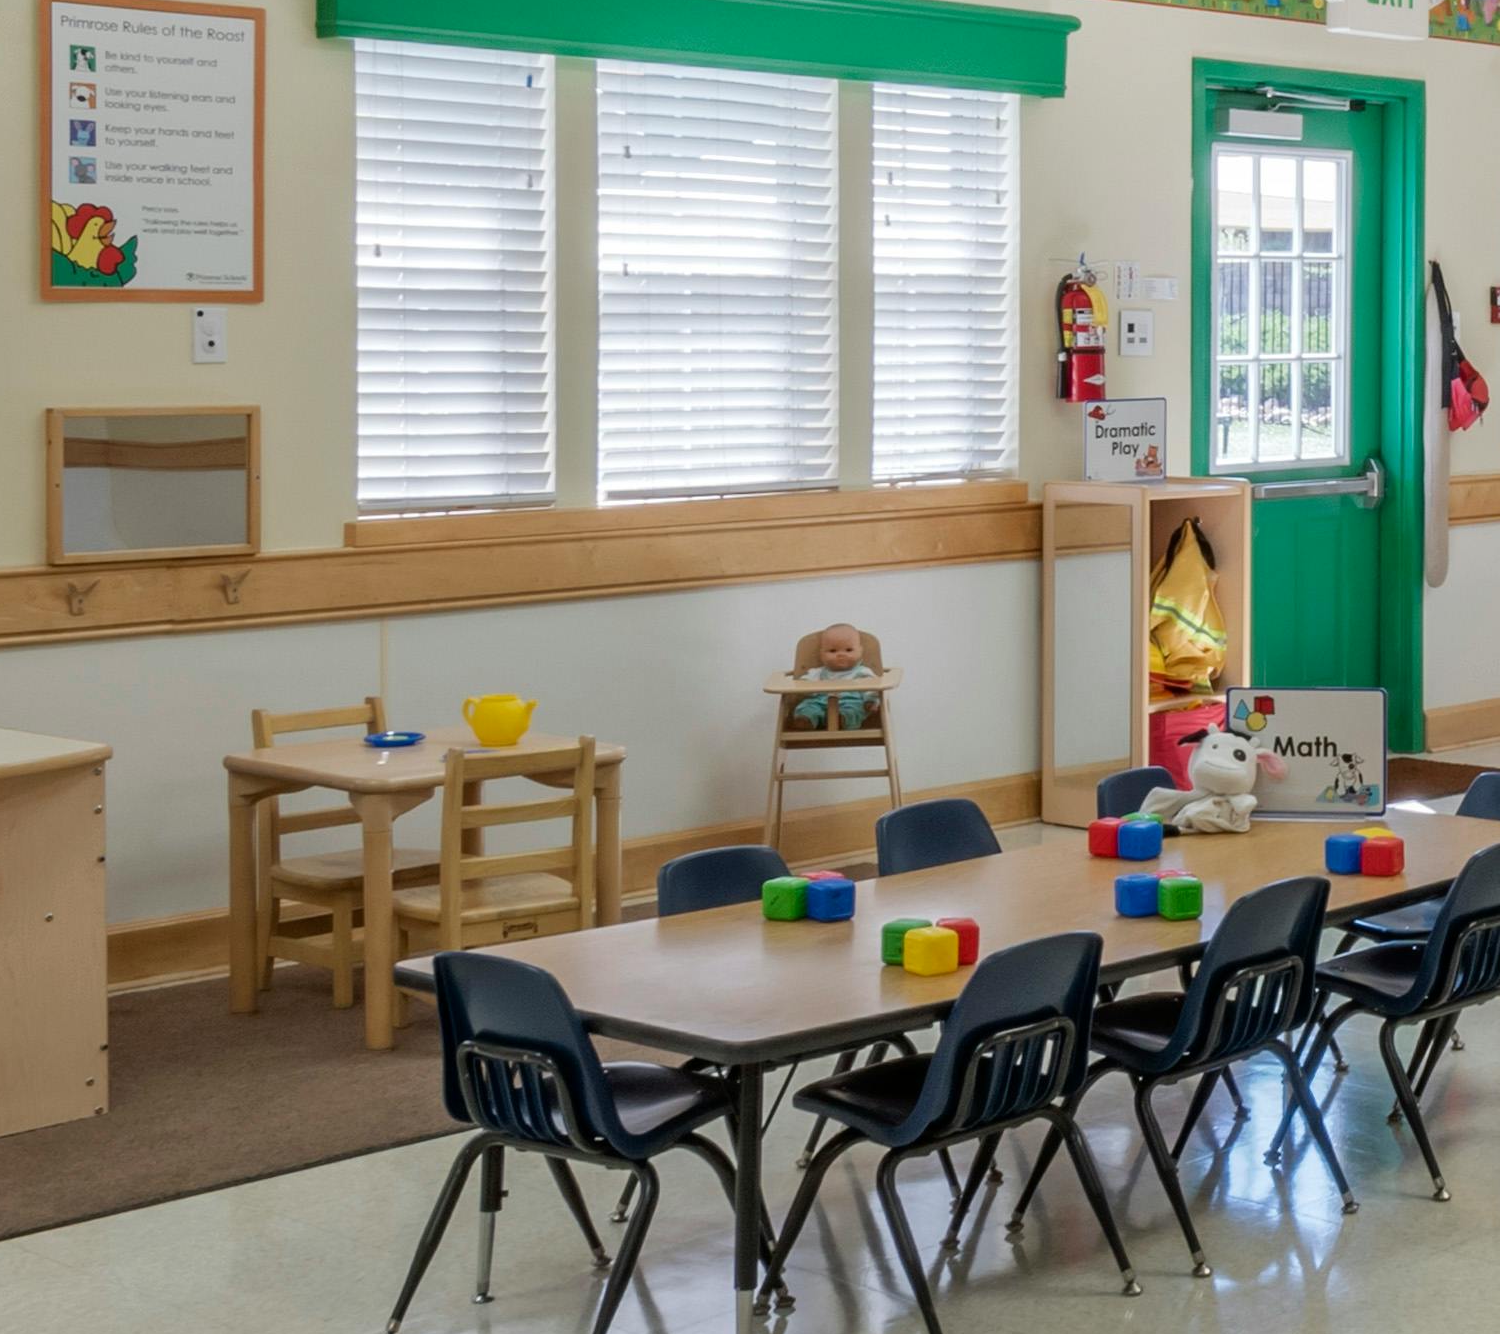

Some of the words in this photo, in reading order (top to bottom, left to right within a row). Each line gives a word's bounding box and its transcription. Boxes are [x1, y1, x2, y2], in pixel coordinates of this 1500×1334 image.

[60, 15, 118, 33] Primrose
[122, 20, 158, 36] Rules
[162, 25, 176, 37] of
[180, 26, 203, 39] the
[207, 28, 245, 42] Roost
[105, 50, 117, 60] Be
[120, 51, 140, 63] kind
[143, 53, 154, 63] to
[156, 55, 195, 68] yourself
[197, 58, 218, 68] and
[105, 64, 138, 75] others.
[104, 87, 123, 97] Use
[125, 89, 147, 99] your
[149, 89, 189, 103] listening
[191, 94, 213, 103] ears
[215, 95, 236, 104] and
[104, 100, 141, 112] looking
[104, 124, 132, 134] Keep
[134, 126, 156, 136] your
[158, 127, 189, 137] hands
[191, 129, 212, 138] and
[214, 130, 235, 139] feet
[104, 137, 116, 146] to
[104, 161, 123, 170] Use
[125, 163, 147, 172] your
[149, 163, 188, 175] walking
[190, 164, 211, 174] feet
[212, 166, 233, 175] and
[104, 174, 133, 183] inside
[136, 175, 163, 184] voice
[166, 175, 175, 184] in
[1095, 422, 1156, 439] Dramatic
[1111, 441, 1140, 457] Play
[1274, 736, 1337, 757] Math
